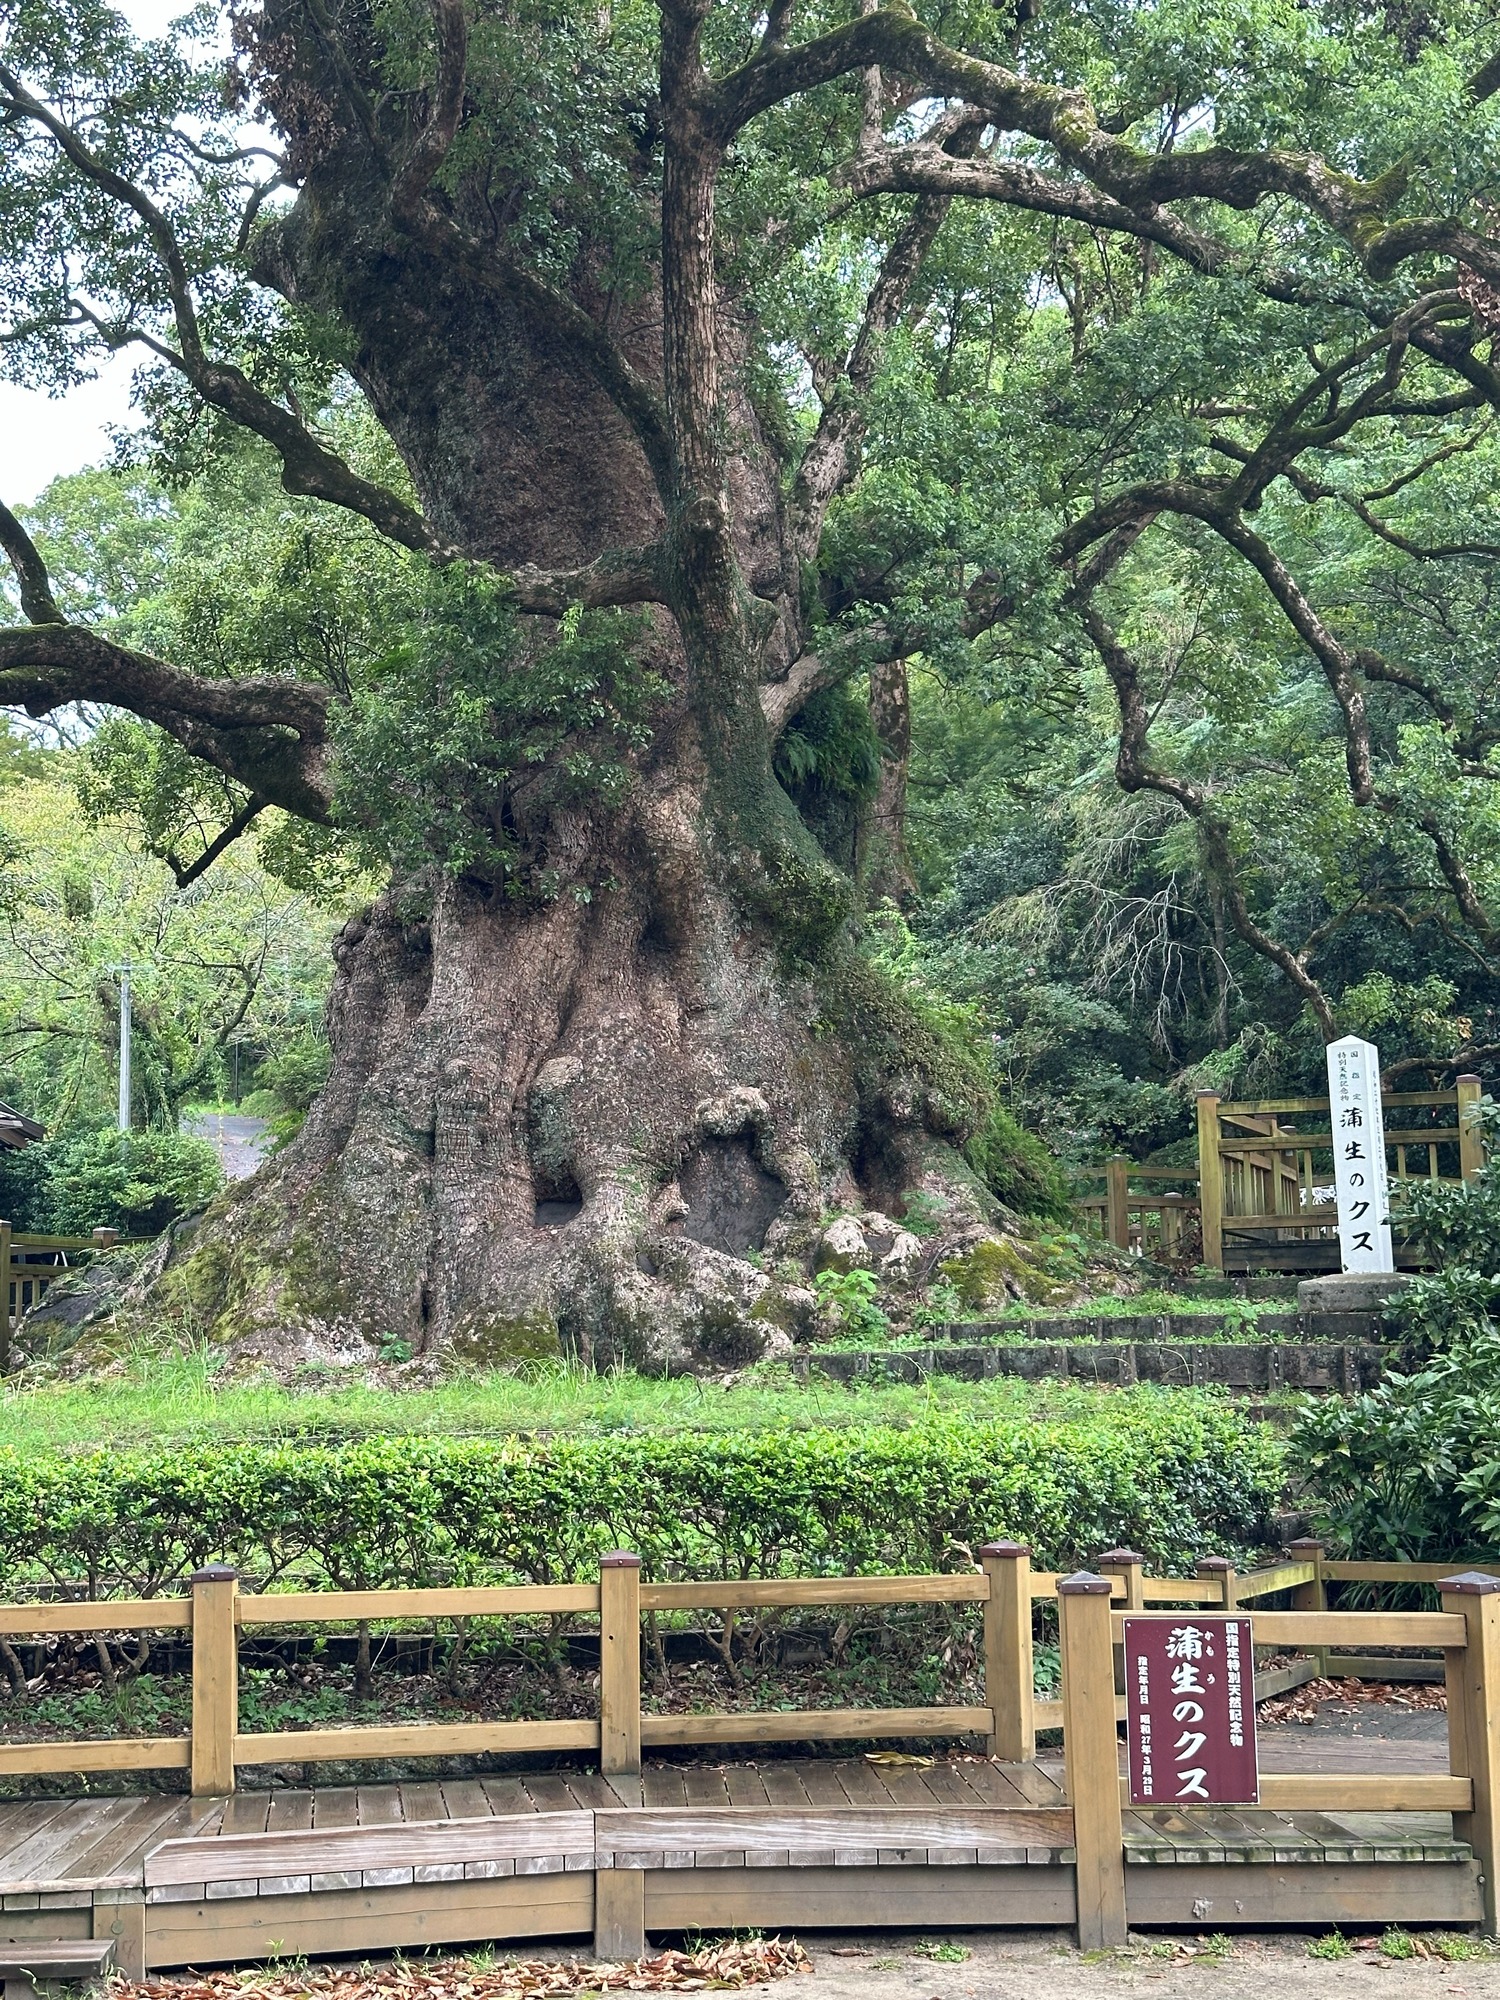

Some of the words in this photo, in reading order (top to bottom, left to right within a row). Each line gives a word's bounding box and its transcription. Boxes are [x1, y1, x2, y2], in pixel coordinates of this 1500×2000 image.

[1338, 1106, 1374, 1252] 蒲生のクス
[1137, 1655, 1149, 1705] 指定年月日
[1204, 1630, 1216, 1685] かもう
[1225, 1622, 1244, 1747] 国指定特別天然記念物
[1139, 1713, 1153, 1796] 昭和27年3月29日
[1164, 1625, 1211, 1799] 蒲生のクス
